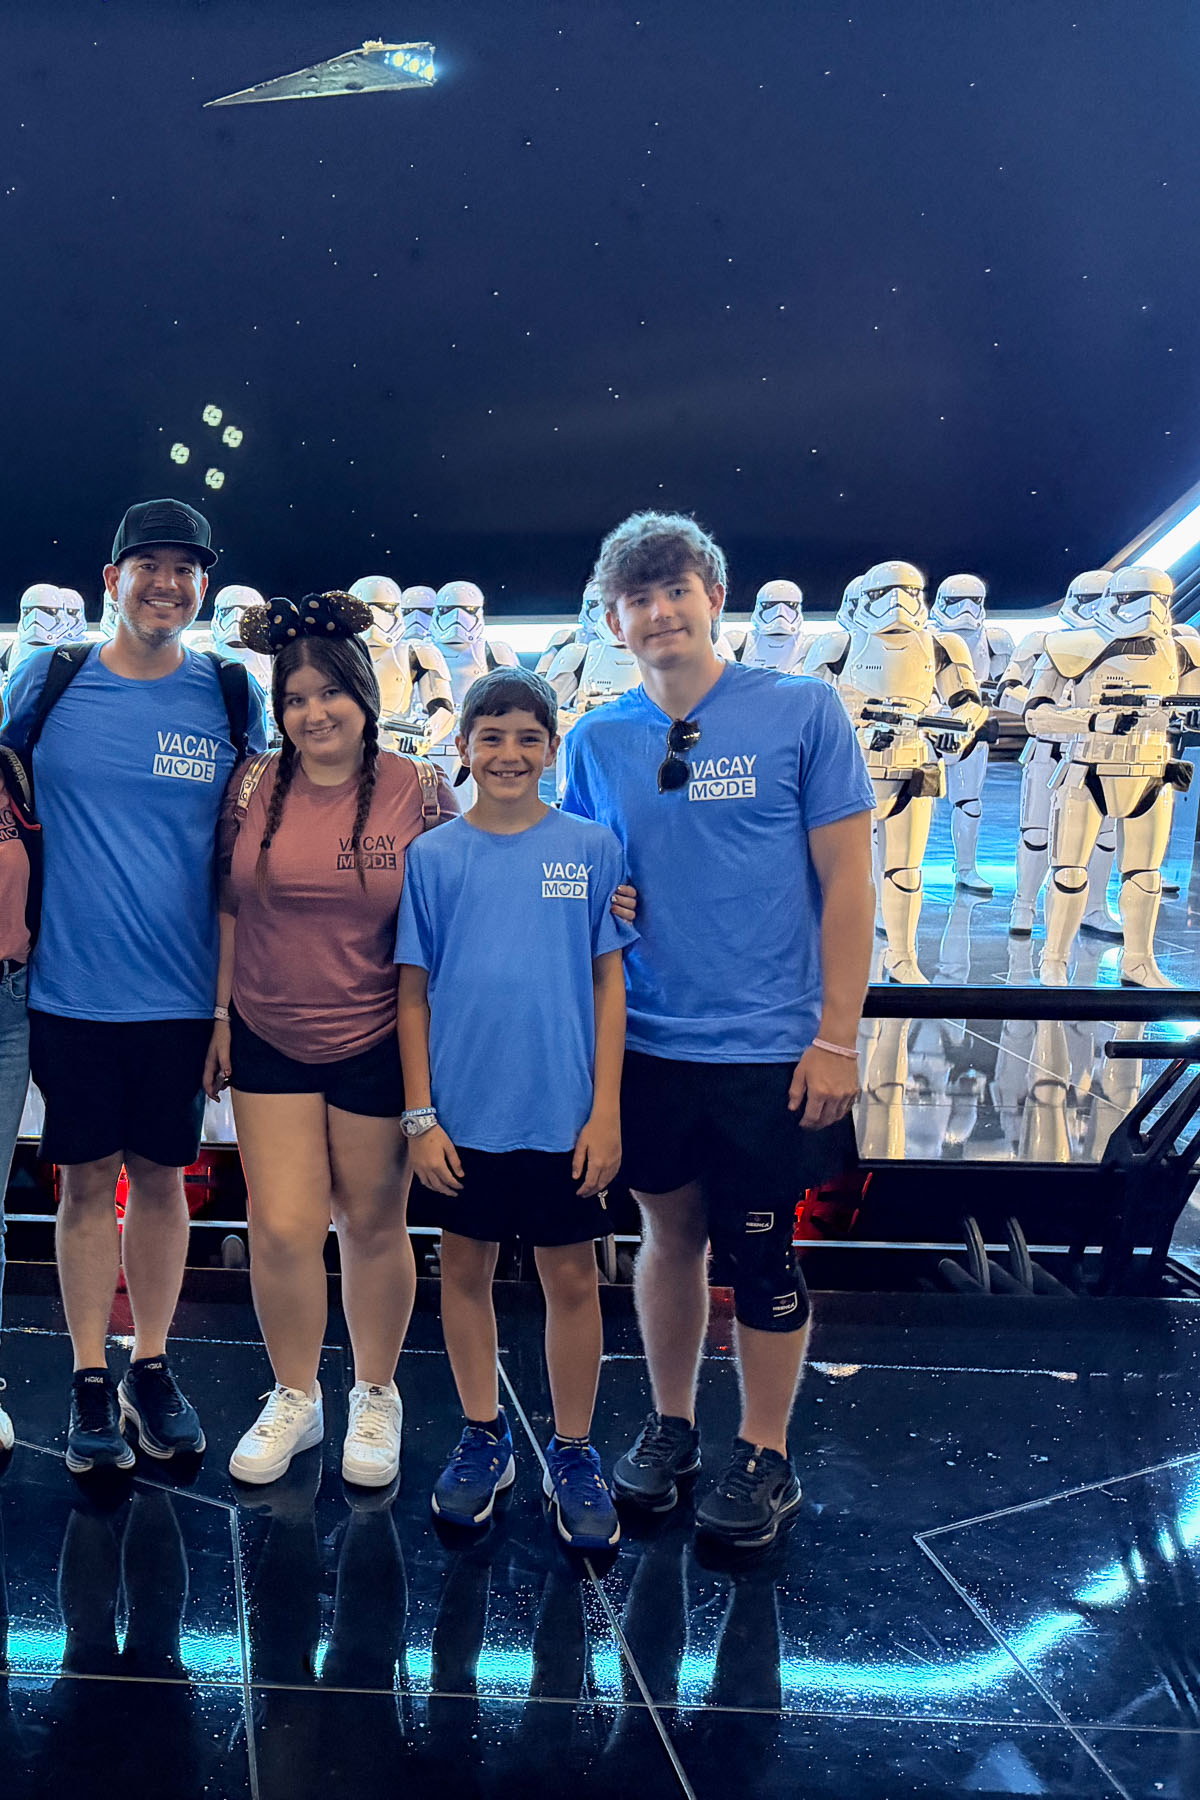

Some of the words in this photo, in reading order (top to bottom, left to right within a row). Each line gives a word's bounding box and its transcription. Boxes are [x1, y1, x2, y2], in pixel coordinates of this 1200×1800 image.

[158, 731, 221, 760] VACAY
[156, 757, 213, 781] MODE
[691, 754, 756, 779] VACAY
[692, 780, 753, 799] MODE
[544, 883, 585, 896] MOD
[85, 1376, 104, 1384] HOKA
